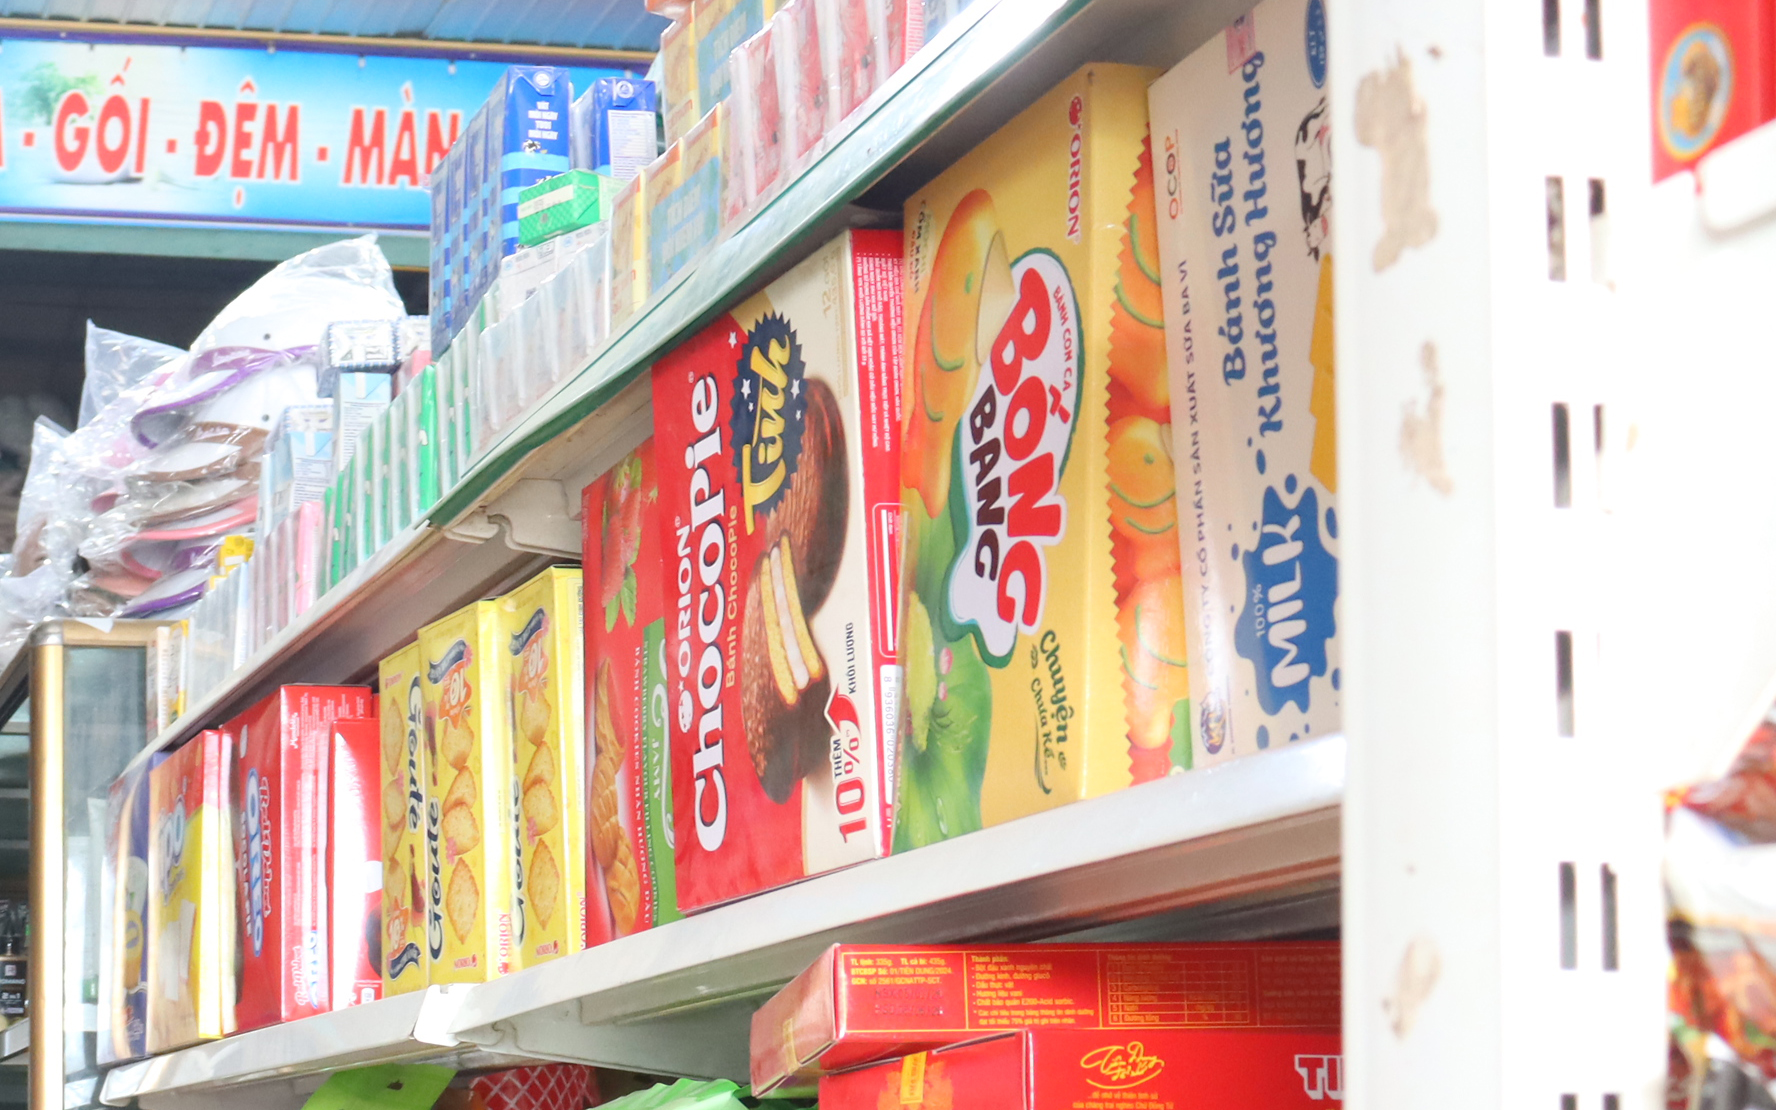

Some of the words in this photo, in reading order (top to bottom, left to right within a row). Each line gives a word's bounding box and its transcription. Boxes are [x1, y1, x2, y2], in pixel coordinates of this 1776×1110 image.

[53, 57, 150, 176] GỐI
[194, 80, 300, 206] ĐỆM
[342, 82, 461, 187] MÀN
[1165, 136, 1179, 219] OCOP
[1241, 51, 1268, 226] Hương
[1067, 133, 1082, 240] ORION
[1212, 137, 1236, 237] Sữa
[1062, 328, 1073, 362] CON
[1183, 319, 1195, 365] SỮA
[1218, 243, 1246, 387] Bánh
[1253, 231, 1283, 437] Khương
[991, 267, 1071, 628] BỐNG
[1186, 371, 1198, 425] XUẤT
[966, 384, 1002, 582] BANG
[1193, 480, 1205, 543] PHẦN
[676, 525, 693, 678] ORION
[727, 505, 738, 621] ChocoPie
[1252, 584, 1266, 638] 100%
[1261, 514, 1311, 688] MILK
[724, 626, 737, 688] Bánh
[845, 621, 855, 661] LƯỢNG
[848, 662, 857, 694] KHỐI
[1040, 630, 1075, 744] Chuyện
[1030, 677, 1048, 728] Chưa
[832, 738, 843, 779] THÊM
[836, 736, 868, 844] 10%
[245, 767, 263, 958] OREO
[499, 913, 509, 958] ORION
